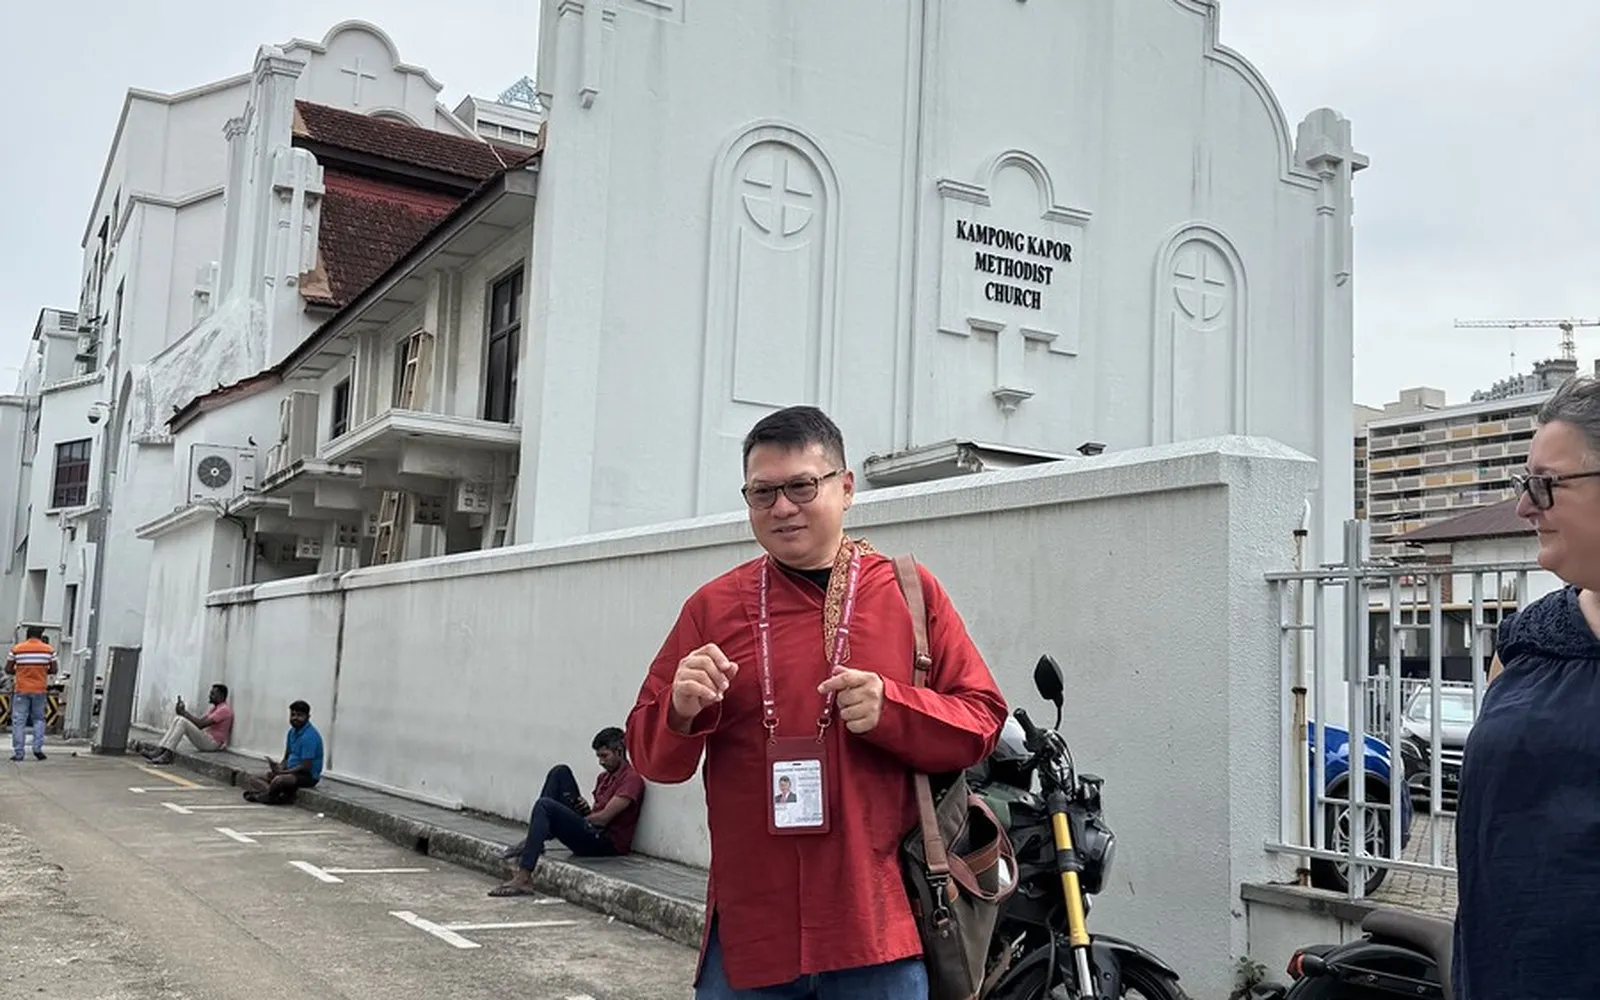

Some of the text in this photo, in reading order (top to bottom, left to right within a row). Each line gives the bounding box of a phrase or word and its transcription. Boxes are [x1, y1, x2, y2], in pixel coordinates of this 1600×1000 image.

[956, 219, 1072, 262] KAMPONG KAPOR
[974, 251, 1053, 285] METHODIST
[985, 281, 1041, 310] CHURCH
